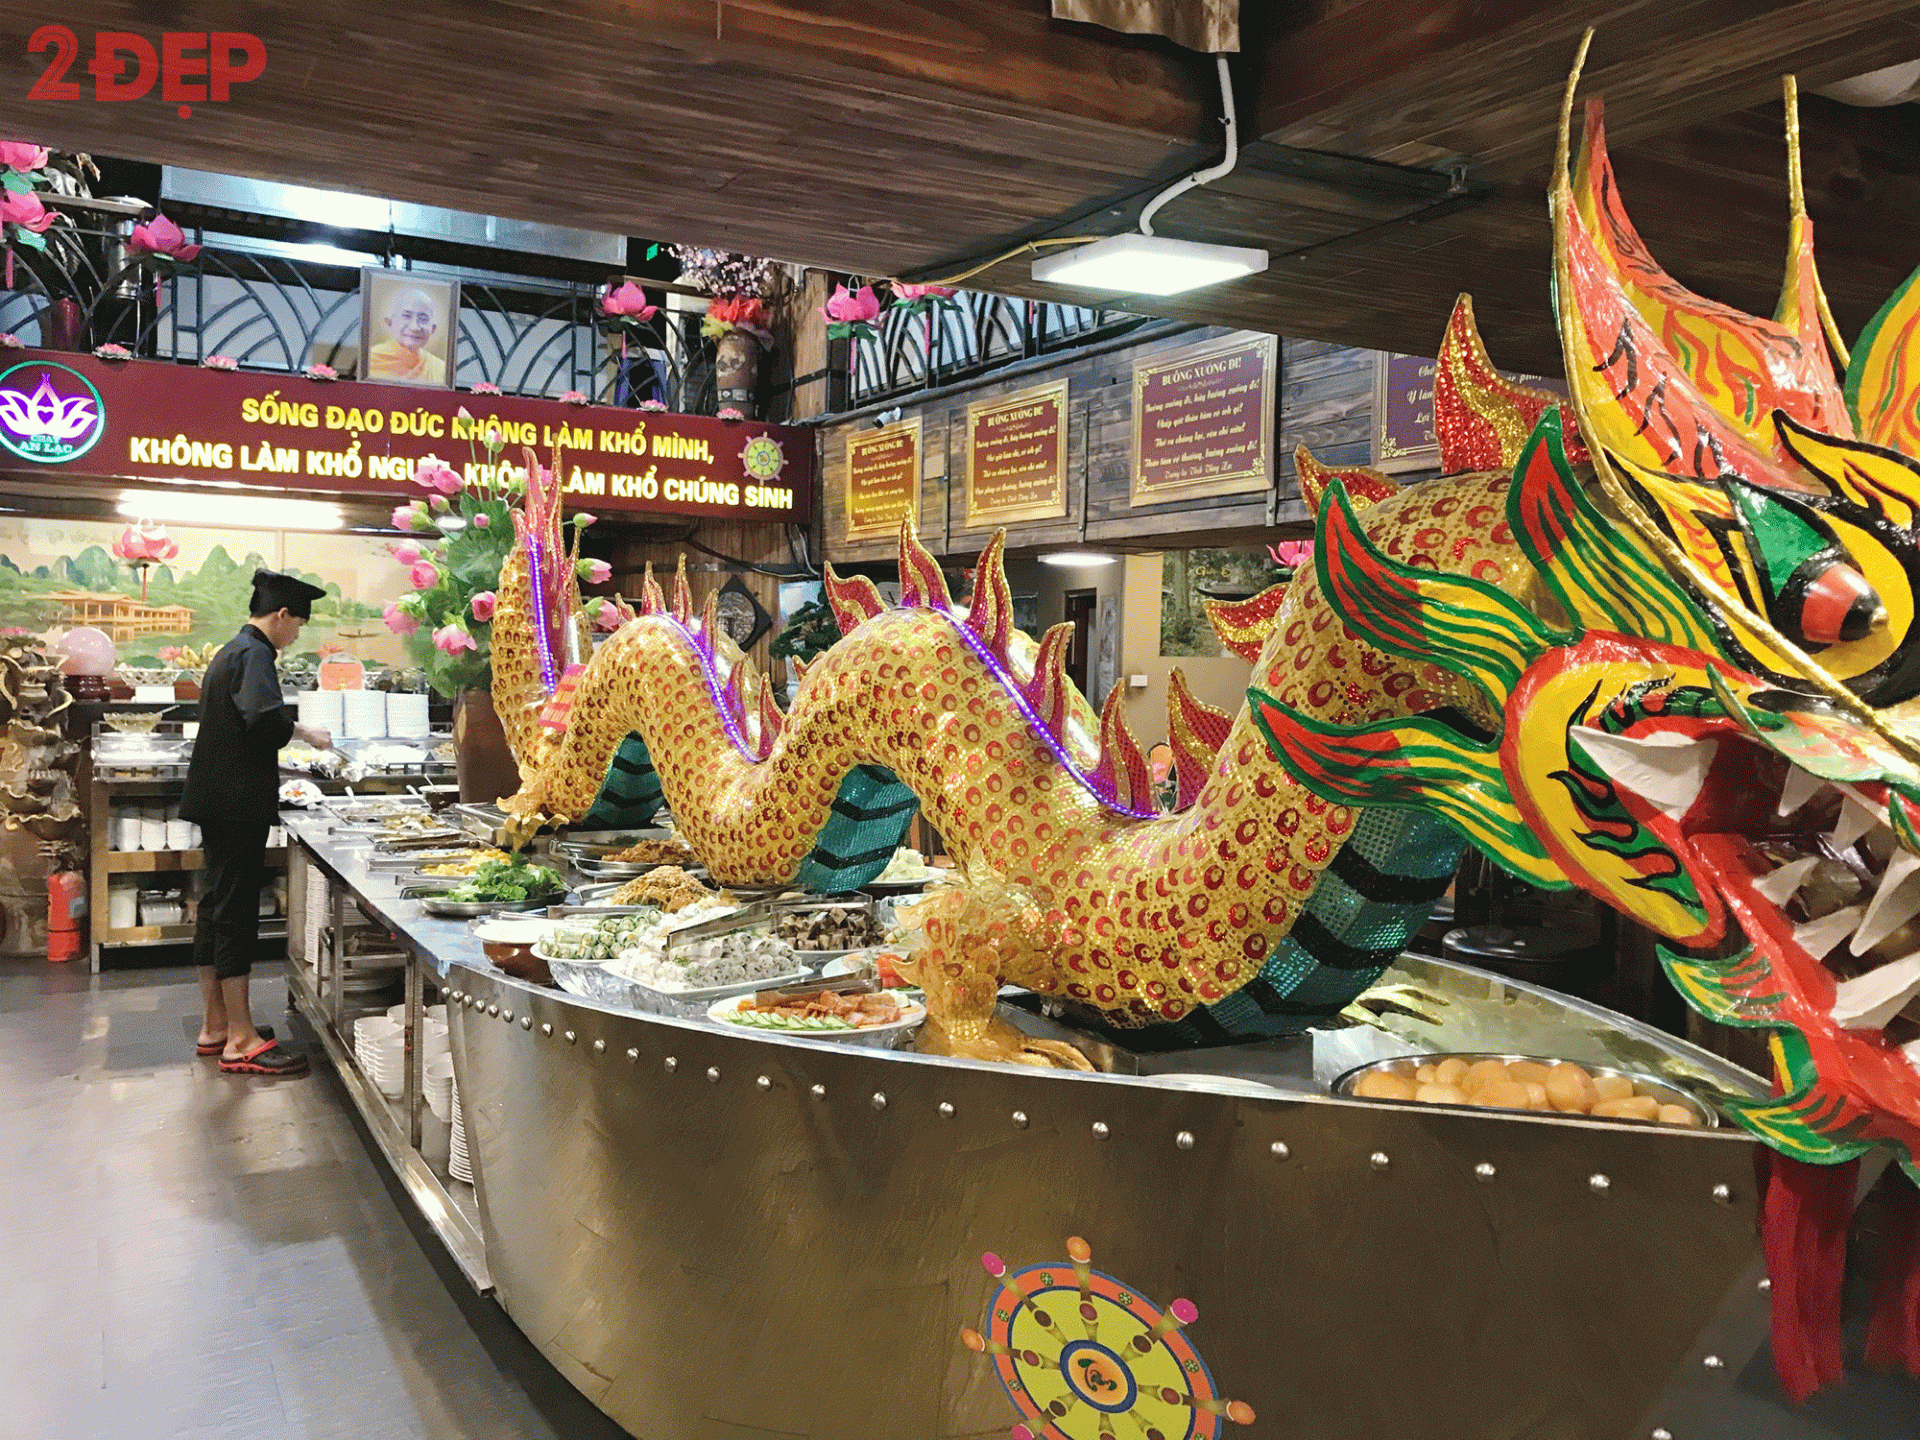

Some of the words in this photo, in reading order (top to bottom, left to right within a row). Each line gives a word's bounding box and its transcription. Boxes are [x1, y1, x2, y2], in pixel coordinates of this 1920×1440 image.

[241, 389, 319, 428] SỐNG
[325, 405, 384, 438] ĐẠO
[389, 407, 445, 438] ĐỨC
[451, 414, 537, 446] KHÔNG
[543, 421, 594, 450] LÀM
[600, 420, 647, 456] KHỔ
[652, 431, 714, 465] MÌNH,
[130, 433, 233, 469] KHÔNG
[240, 440, 299, 474] LÀM
[306, 440, 363, 478] KHỔ
[611, 465, 658, 500] KHỔ
[663, 476, 740, 506] CHÚNG
[744, 485, 793, 510] SINH
